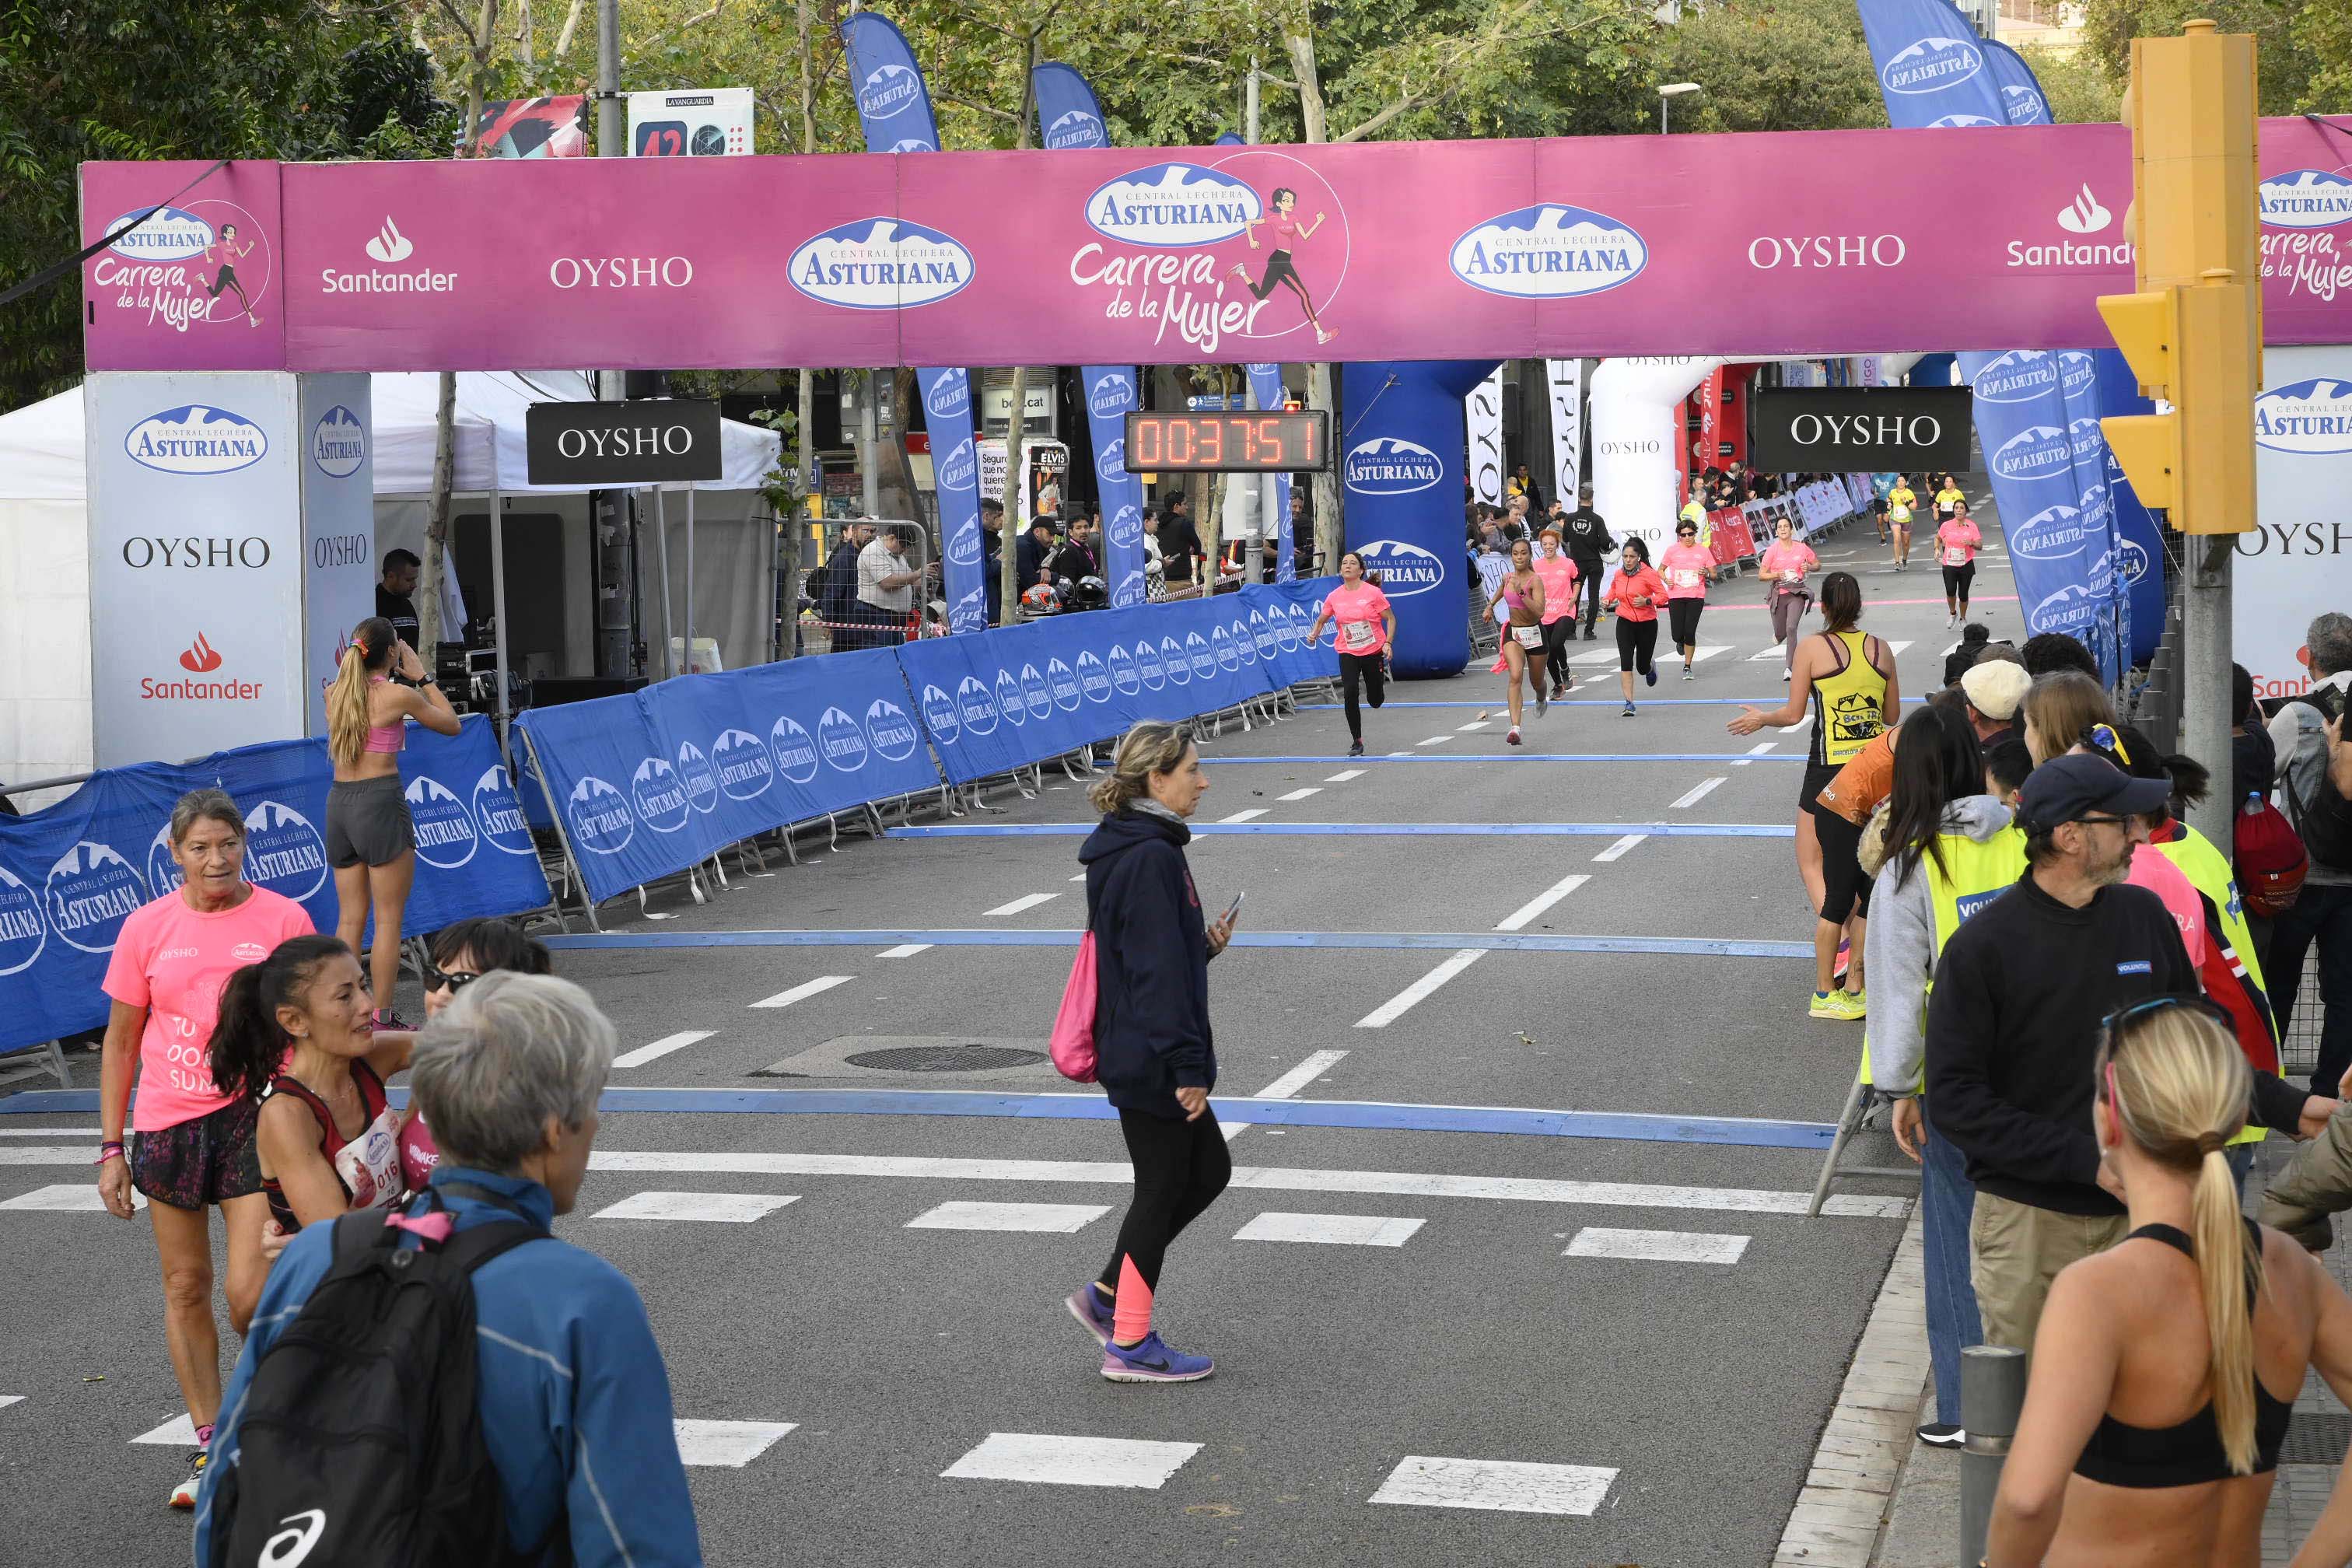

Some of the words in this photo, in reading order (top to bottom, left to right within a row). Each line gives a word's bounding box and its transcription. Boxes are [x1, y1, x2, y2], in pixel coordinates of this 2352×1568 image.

[1125, 191, 1181, 201] CENTRAL
[1187, 191, 1243, 200] LECHERA
[1099, 194, 1248, 226] ASTURIANA
[112, 226, 206, 247] ASTURIANA
[1496, 236, 1556, 247] CENTRAL
[1563, 235, 1626, 245] LECHERA
[2259, 232, 2335, 255] arrera
[830, 249, 887, 258] CENTRAL
[894, 247, 954, 257] LECHERA
[1069, 243, 1216, 286] Carrera
[1465, 240, 1633, 275] ASTURIANA
[1748, 234, 1906, 268] OYSHO
[2007, 240, 2135, 267] Santand
[94, 257, 186, 287] Carrera
[322, 268, 457, 293] Santander
[550, 256, 694, 289] OYSHO
[801, 251, 961, 286] ASTURIANA
[2278, 255, 2293, 277] la
[2288, 250, 2352, 302] Muje
[117, 288, 135, 308] de
[138, 286, 150, 308] la
[148, 285, 221, 332] Mujer
[1106, 289, 1133, 318] de
[1139, 286, 1158, 318] la
[1154, 282, 1270, 354] Mujer
[2255, 408, 2352, 436] ASTURI
[2277, 404, 2329, 413] CENTRAL
[157, 429, 203, 437] CENTRAL
[206, 428, 254, 436] LECHERA
[558, 425, 693, 458] OYSHO
[1138, 420, 1312, 463] 00:37:51
[1790, 415, 1941, 446] OYSHO
[137, 431, 258, 458] ASTURIANA
[317, 432, 362, 460] ASTURIANA
[1601, 439, 1661, 456] OYSHO
[982, 466, 996, 476] que
[1041, 453, 1065, 464] ELVIS
[1348, 460, 1436, 482] ASTURIANA
[122, 536, 271, 569] OYSHO
[314, 533, 366, 569] OYSHO
[141, 677, 262, 699] Santander
[823, 734, 866, 758] ASTURIANA
[716, 758, 772, 786] ASTURIANA
[414, 807, 436, 820] CENTRAL
[487, 797, 513, 807] CENTRAL
[254, 837, 282, 850] CENTRAL
[283, 830, 312, 844] LECHERA
[412, 817, 474, 849] ASTURIANA
[246, 844, 324, 883] ASTURIANA
[63, 879, 97, 894] CENTRAL
[54, 884, 142, 931] ASTURIANA
[159, 947, 198, 961] OYSHO
[173, 1017, 196, 1038] TU
